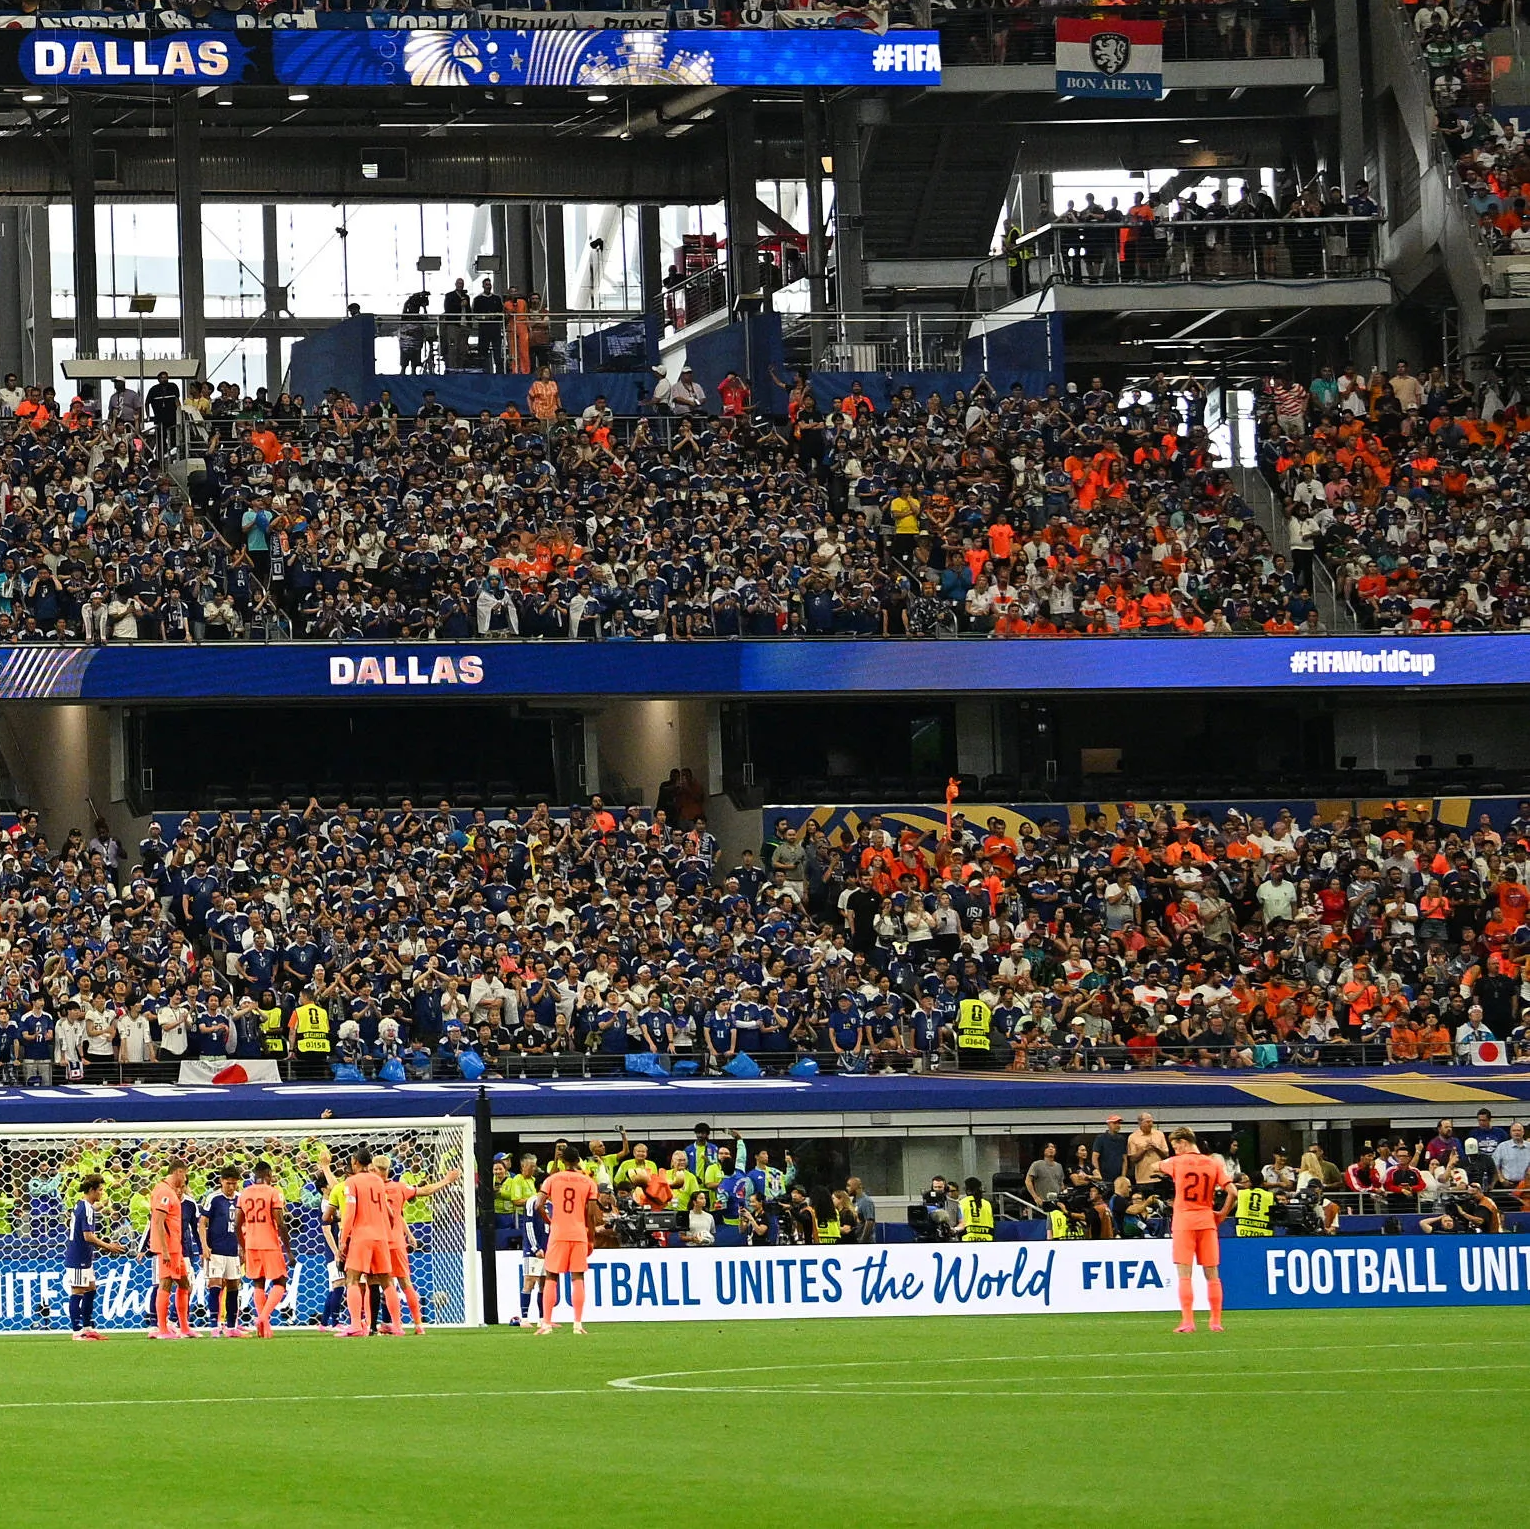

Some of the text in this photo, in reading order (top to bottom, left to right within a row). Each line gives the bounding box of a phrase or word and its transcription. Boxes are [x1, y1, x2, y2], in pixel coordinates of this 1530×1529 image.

[33, 39, 231, 77] DALLAS
[1066, 77, 1098, 90] BON
[1135, 79, 1154, 91] VA
[330, 655, 485, 685] DALLAS
[1290, 648, 1436, 677] #FIFAWorldCup
[966, 907, 983, 918] USA
[370, 1188, 382, 1212] 4
[563, 1187, 576, 1214] 8
[1184, 1172, 1211, 1201] 21
[245, 1197, 267, 1223] 22
[715, 1257, 842, 1305] UNITES
[853, 1249, 924, 1306] the
[931, 1246, 1056, 1307] World
[1083, 1260, 1164, 1290] FIFA
[1267, 1247, 1447, 1295] FOOTBALL
